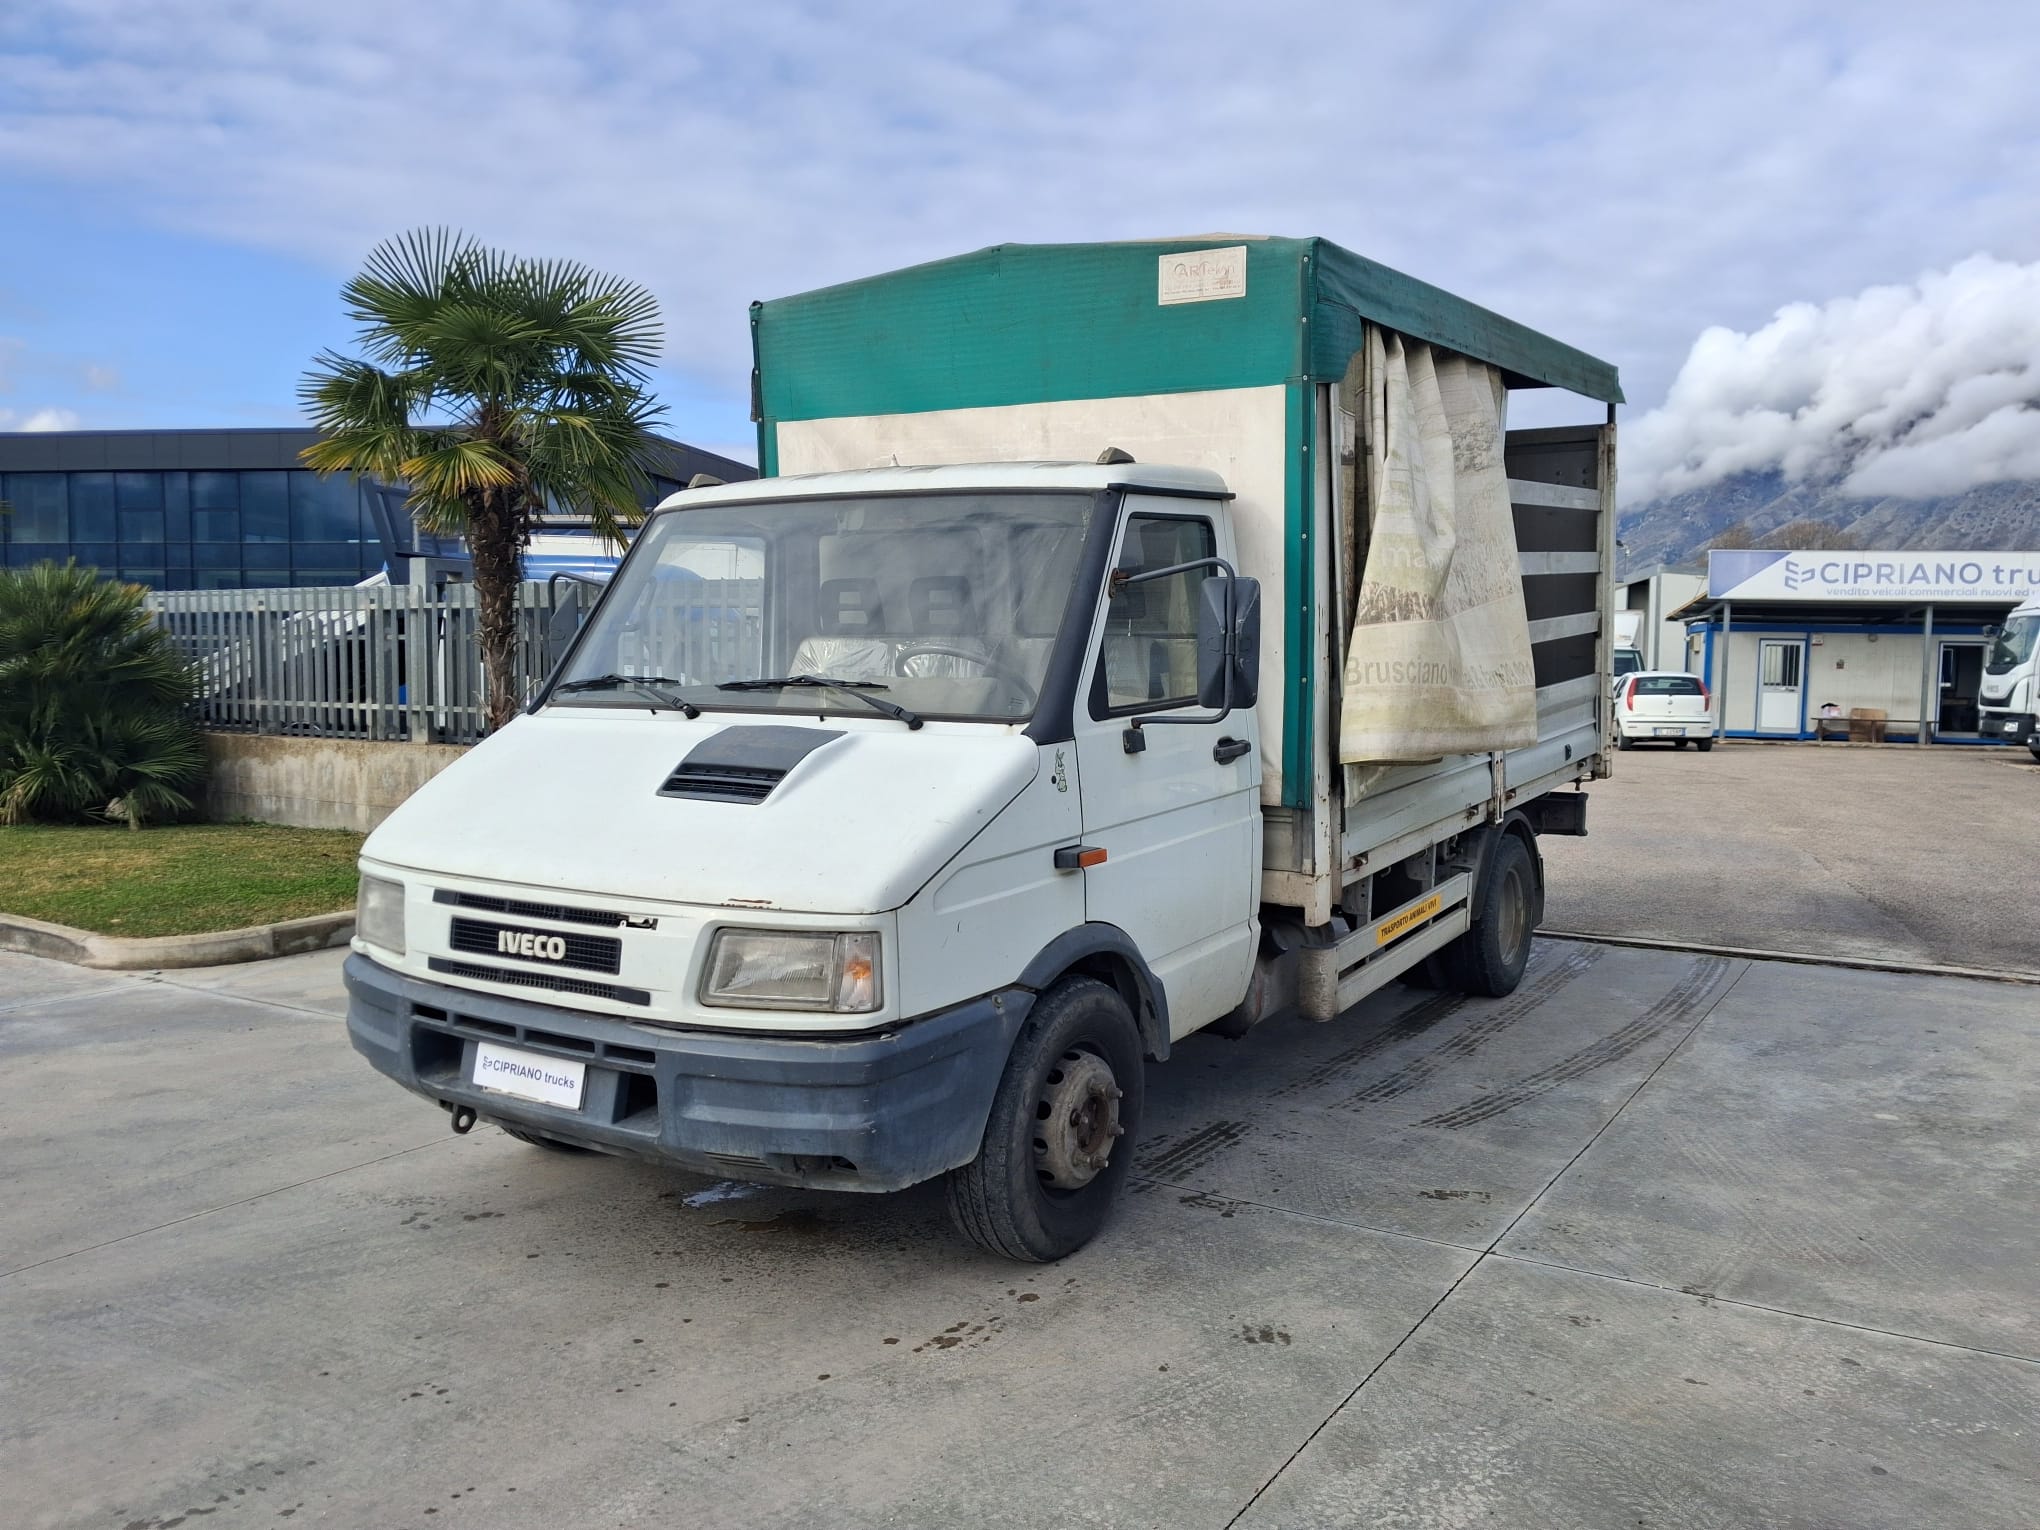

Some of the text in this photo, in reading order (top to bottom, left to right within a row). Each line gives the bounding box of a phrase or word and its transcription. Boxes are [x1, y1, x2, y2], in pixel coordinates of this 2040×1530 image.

[1820, 562, 1983, 585] CIPRIANO
[1826, 587, 1870, 597] vendita
[1872, 587, 1907, 597] veicoli
[1909, 587, 1978, 597] commerciali
[1981, 587, 2012, 597] nuovi
[2014, 587, 2030, 597] ed
[1344, 656, 1448, 686] Brusciano
[1381, 898, 1437, 937] TRASPORTO ANIMALI VIVI
[498, 930, 566, 960] IVECO
[493, 1059, 575, 1089] CIPRIANO trucks
